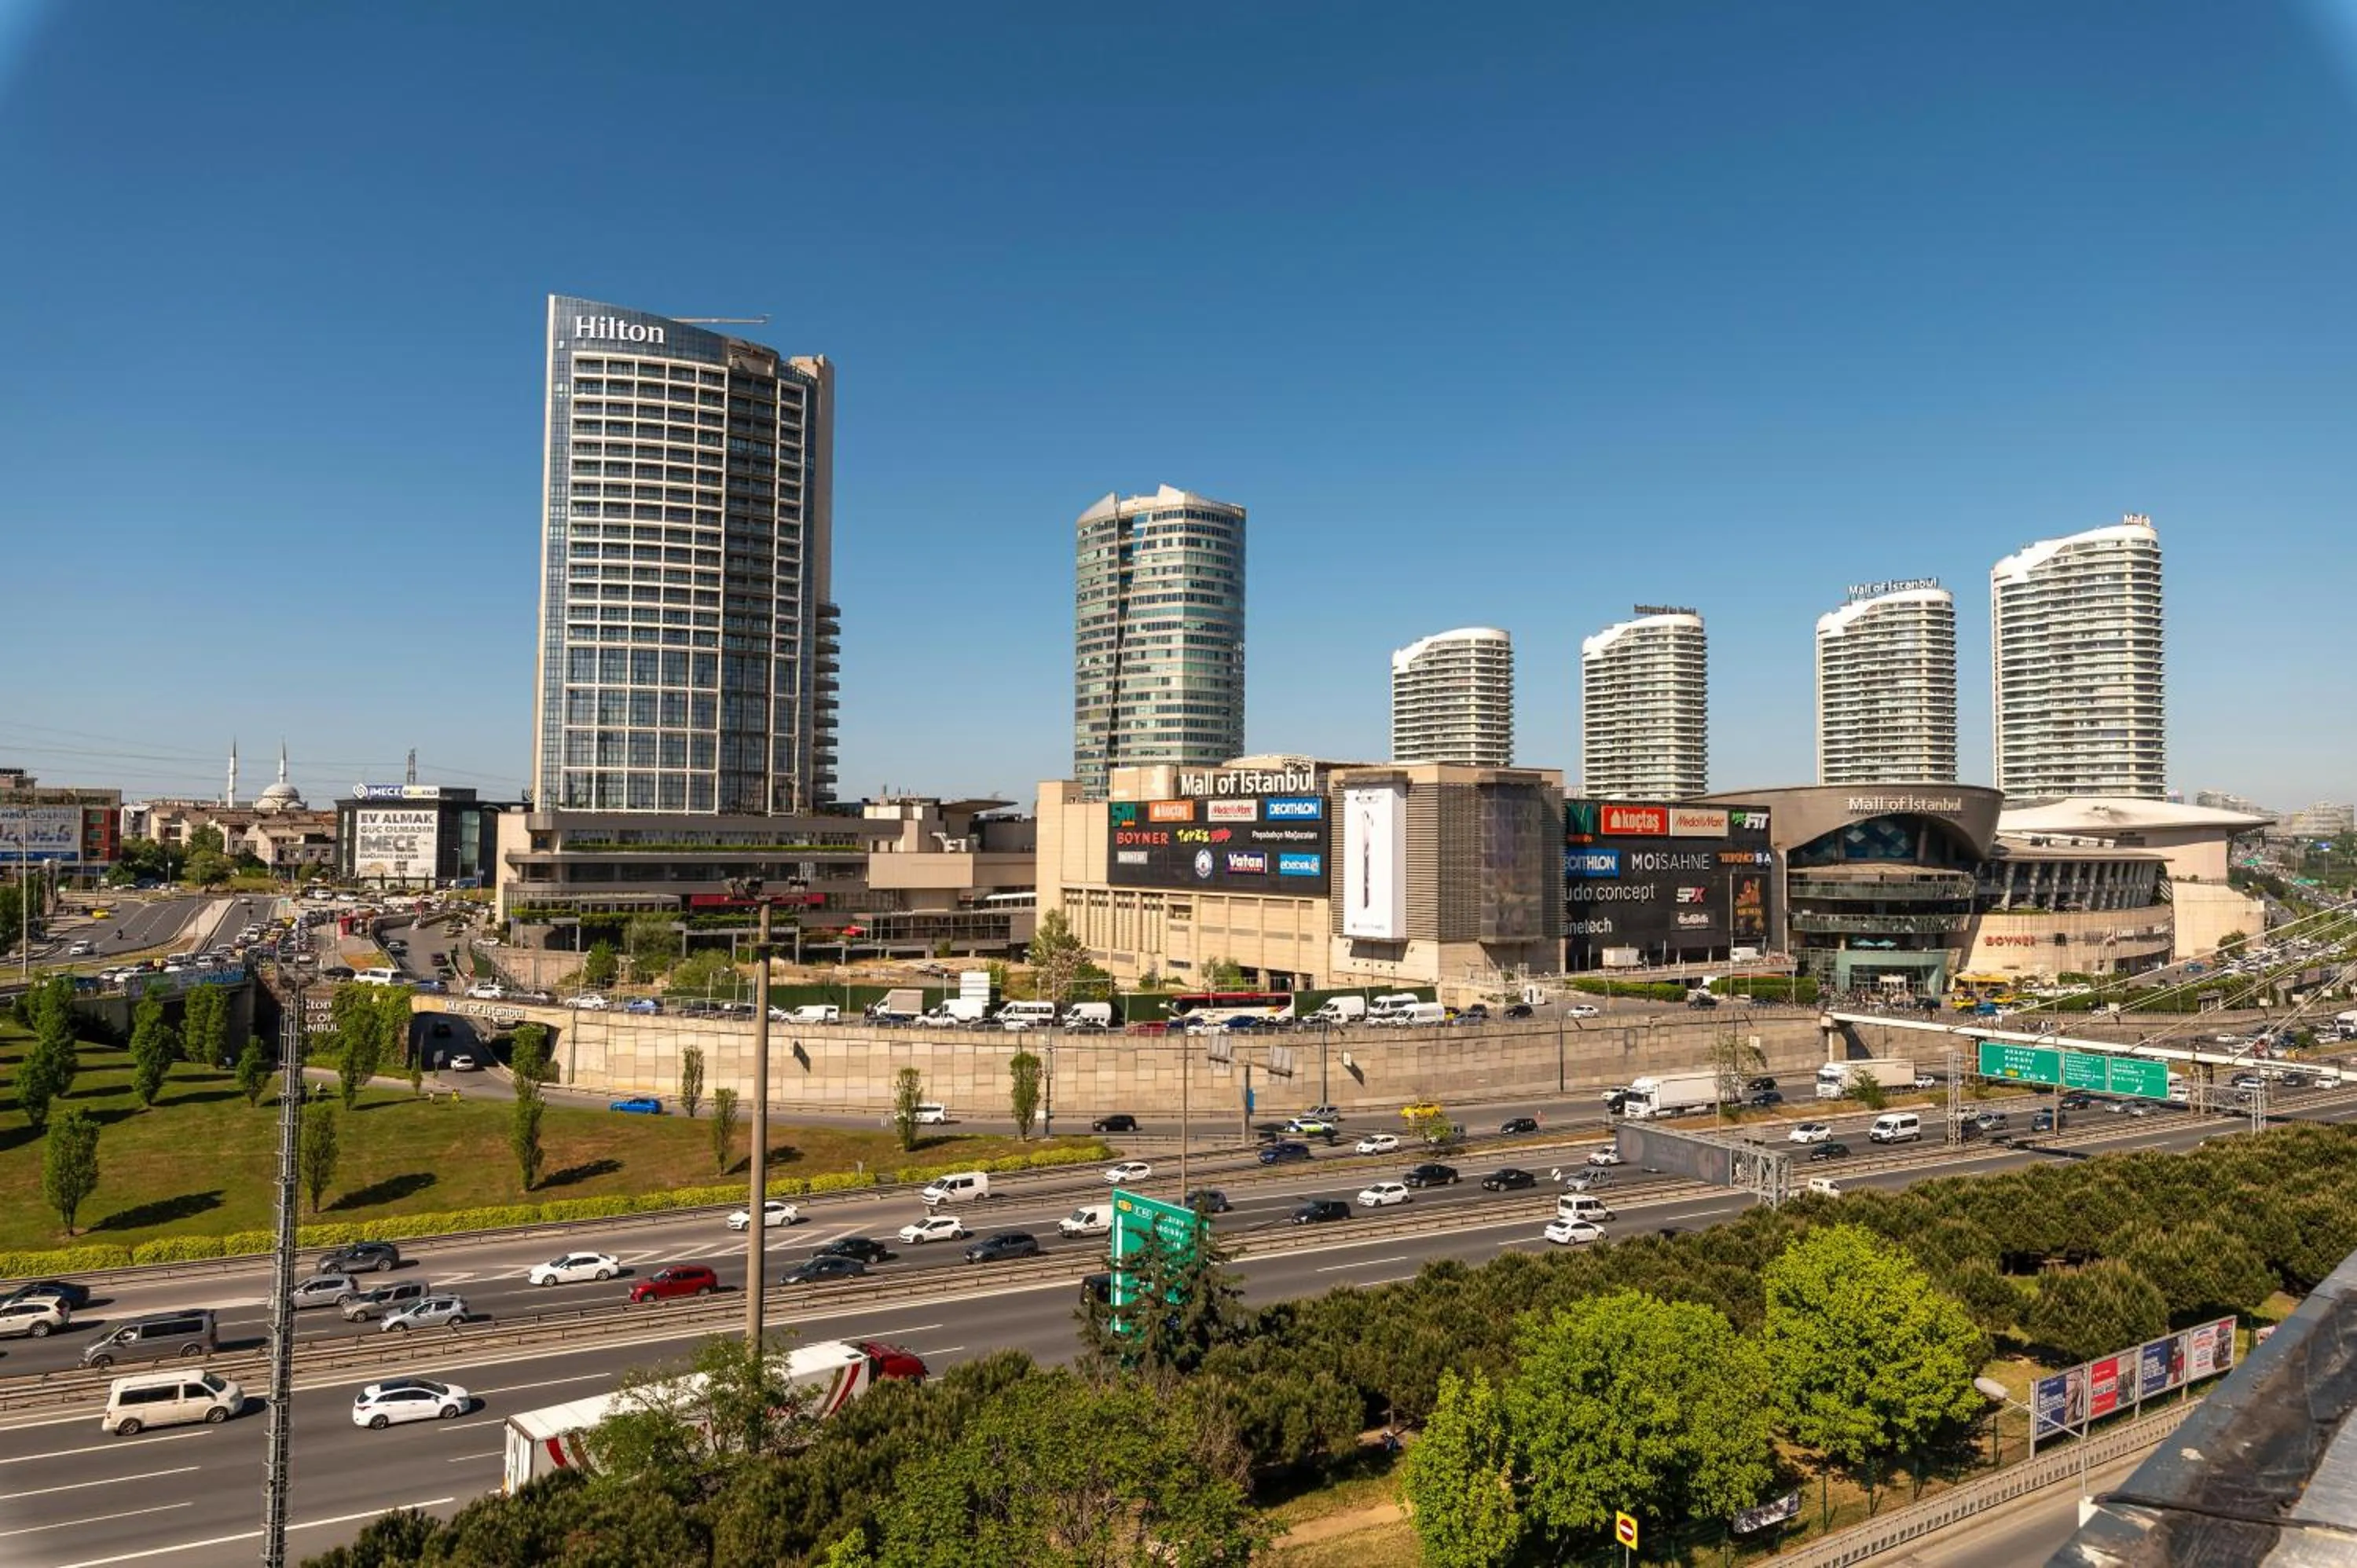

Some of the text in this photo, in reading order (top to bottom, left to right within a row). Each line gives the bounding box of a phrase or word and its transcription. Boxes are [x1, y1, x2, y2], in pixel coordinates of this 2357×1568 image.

[575, 315, 664, 343] Hilton
[1848, 584, 1871, 595] Mall
[1181, 764, 1315, 796] Mall of Istanbul
[1269, 802, 1318, 815] DECATHLON
[1848, 797, 1883, 811] Mall
[1889, 797, 1905, 810] of
[361, 813, 434, 824] EV ALMAK
[1116, 831, 1169, 845] BOYNER
[1228, 852, 1265, 868] Vatan
[1676, 886, 1706, 903] SPX
